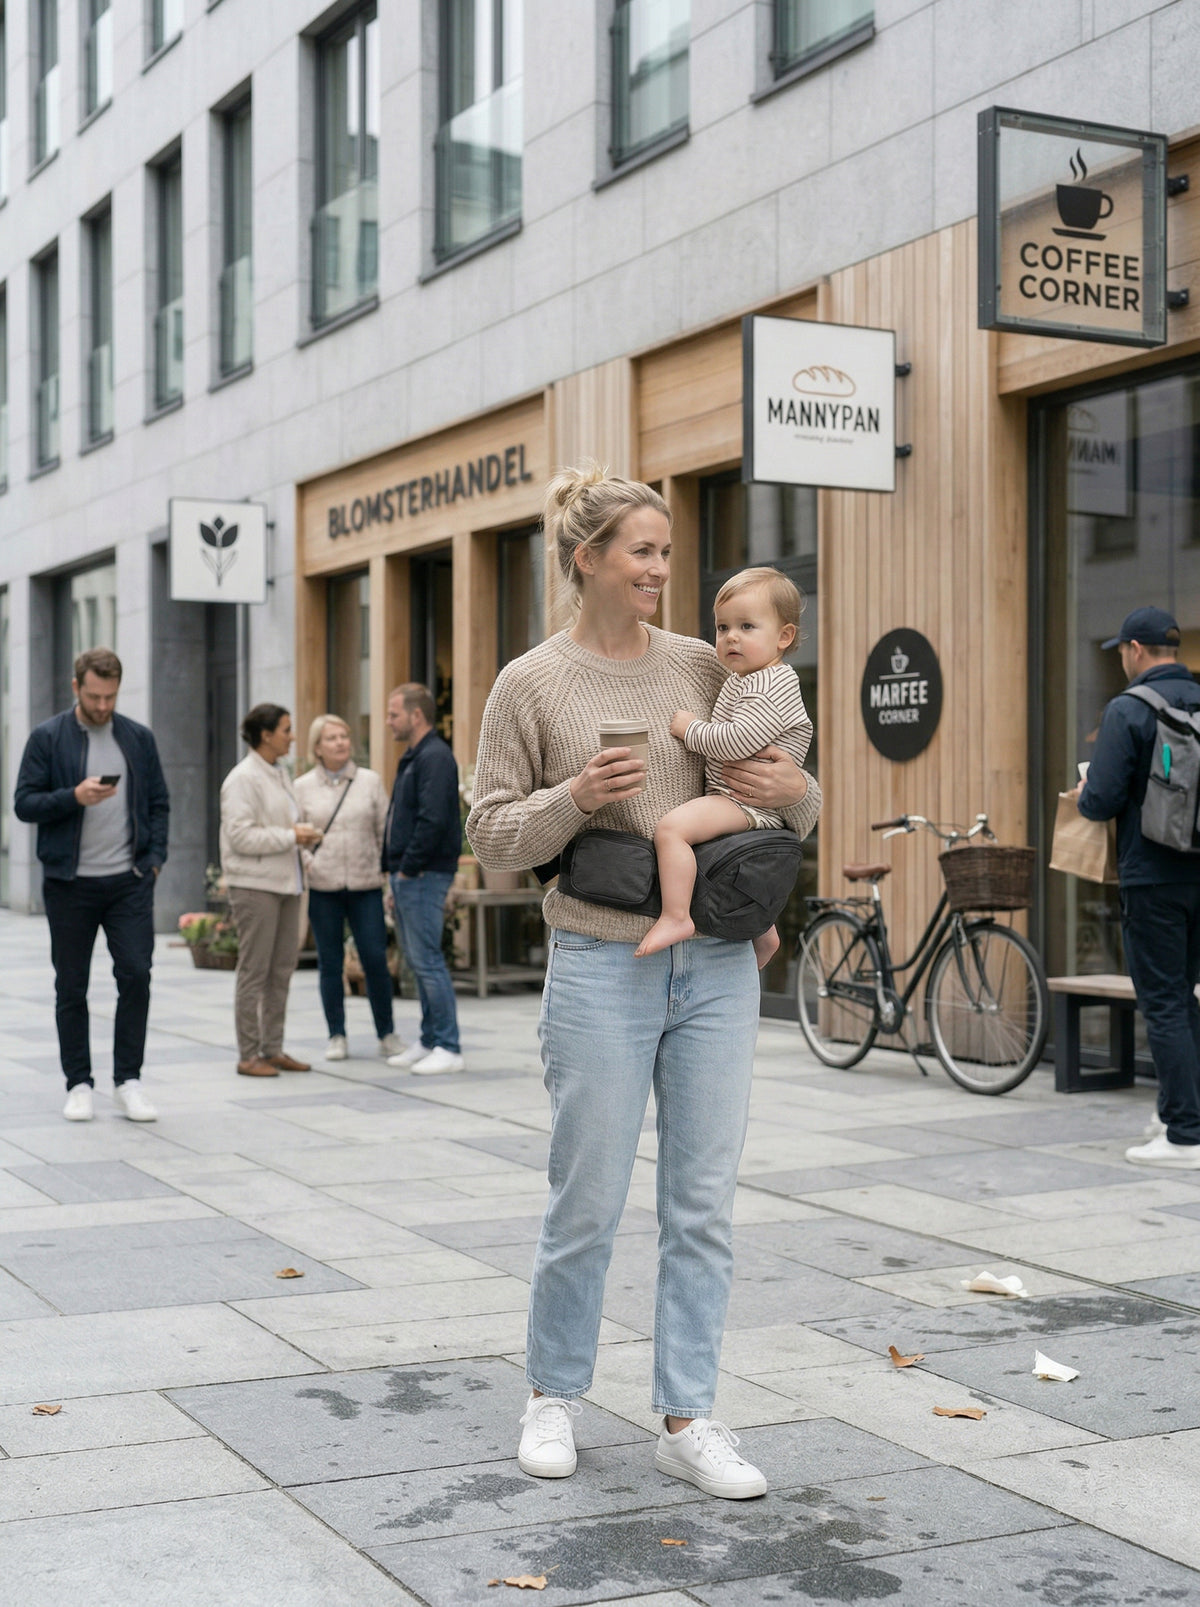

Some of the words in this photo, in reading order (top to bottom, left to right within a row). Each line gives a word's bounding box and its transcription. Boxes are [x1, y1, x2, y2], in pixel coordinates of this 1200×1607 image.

[1020, 242, 1140, 281] COFFEE
[1019, 274, 1140, 312] CORNER
[768, 397, 880, 433] MANNYPAN
[328, 444, 532, 539] BLOMSTERHANDEL
[878, 708, 919, 725] CORNER
